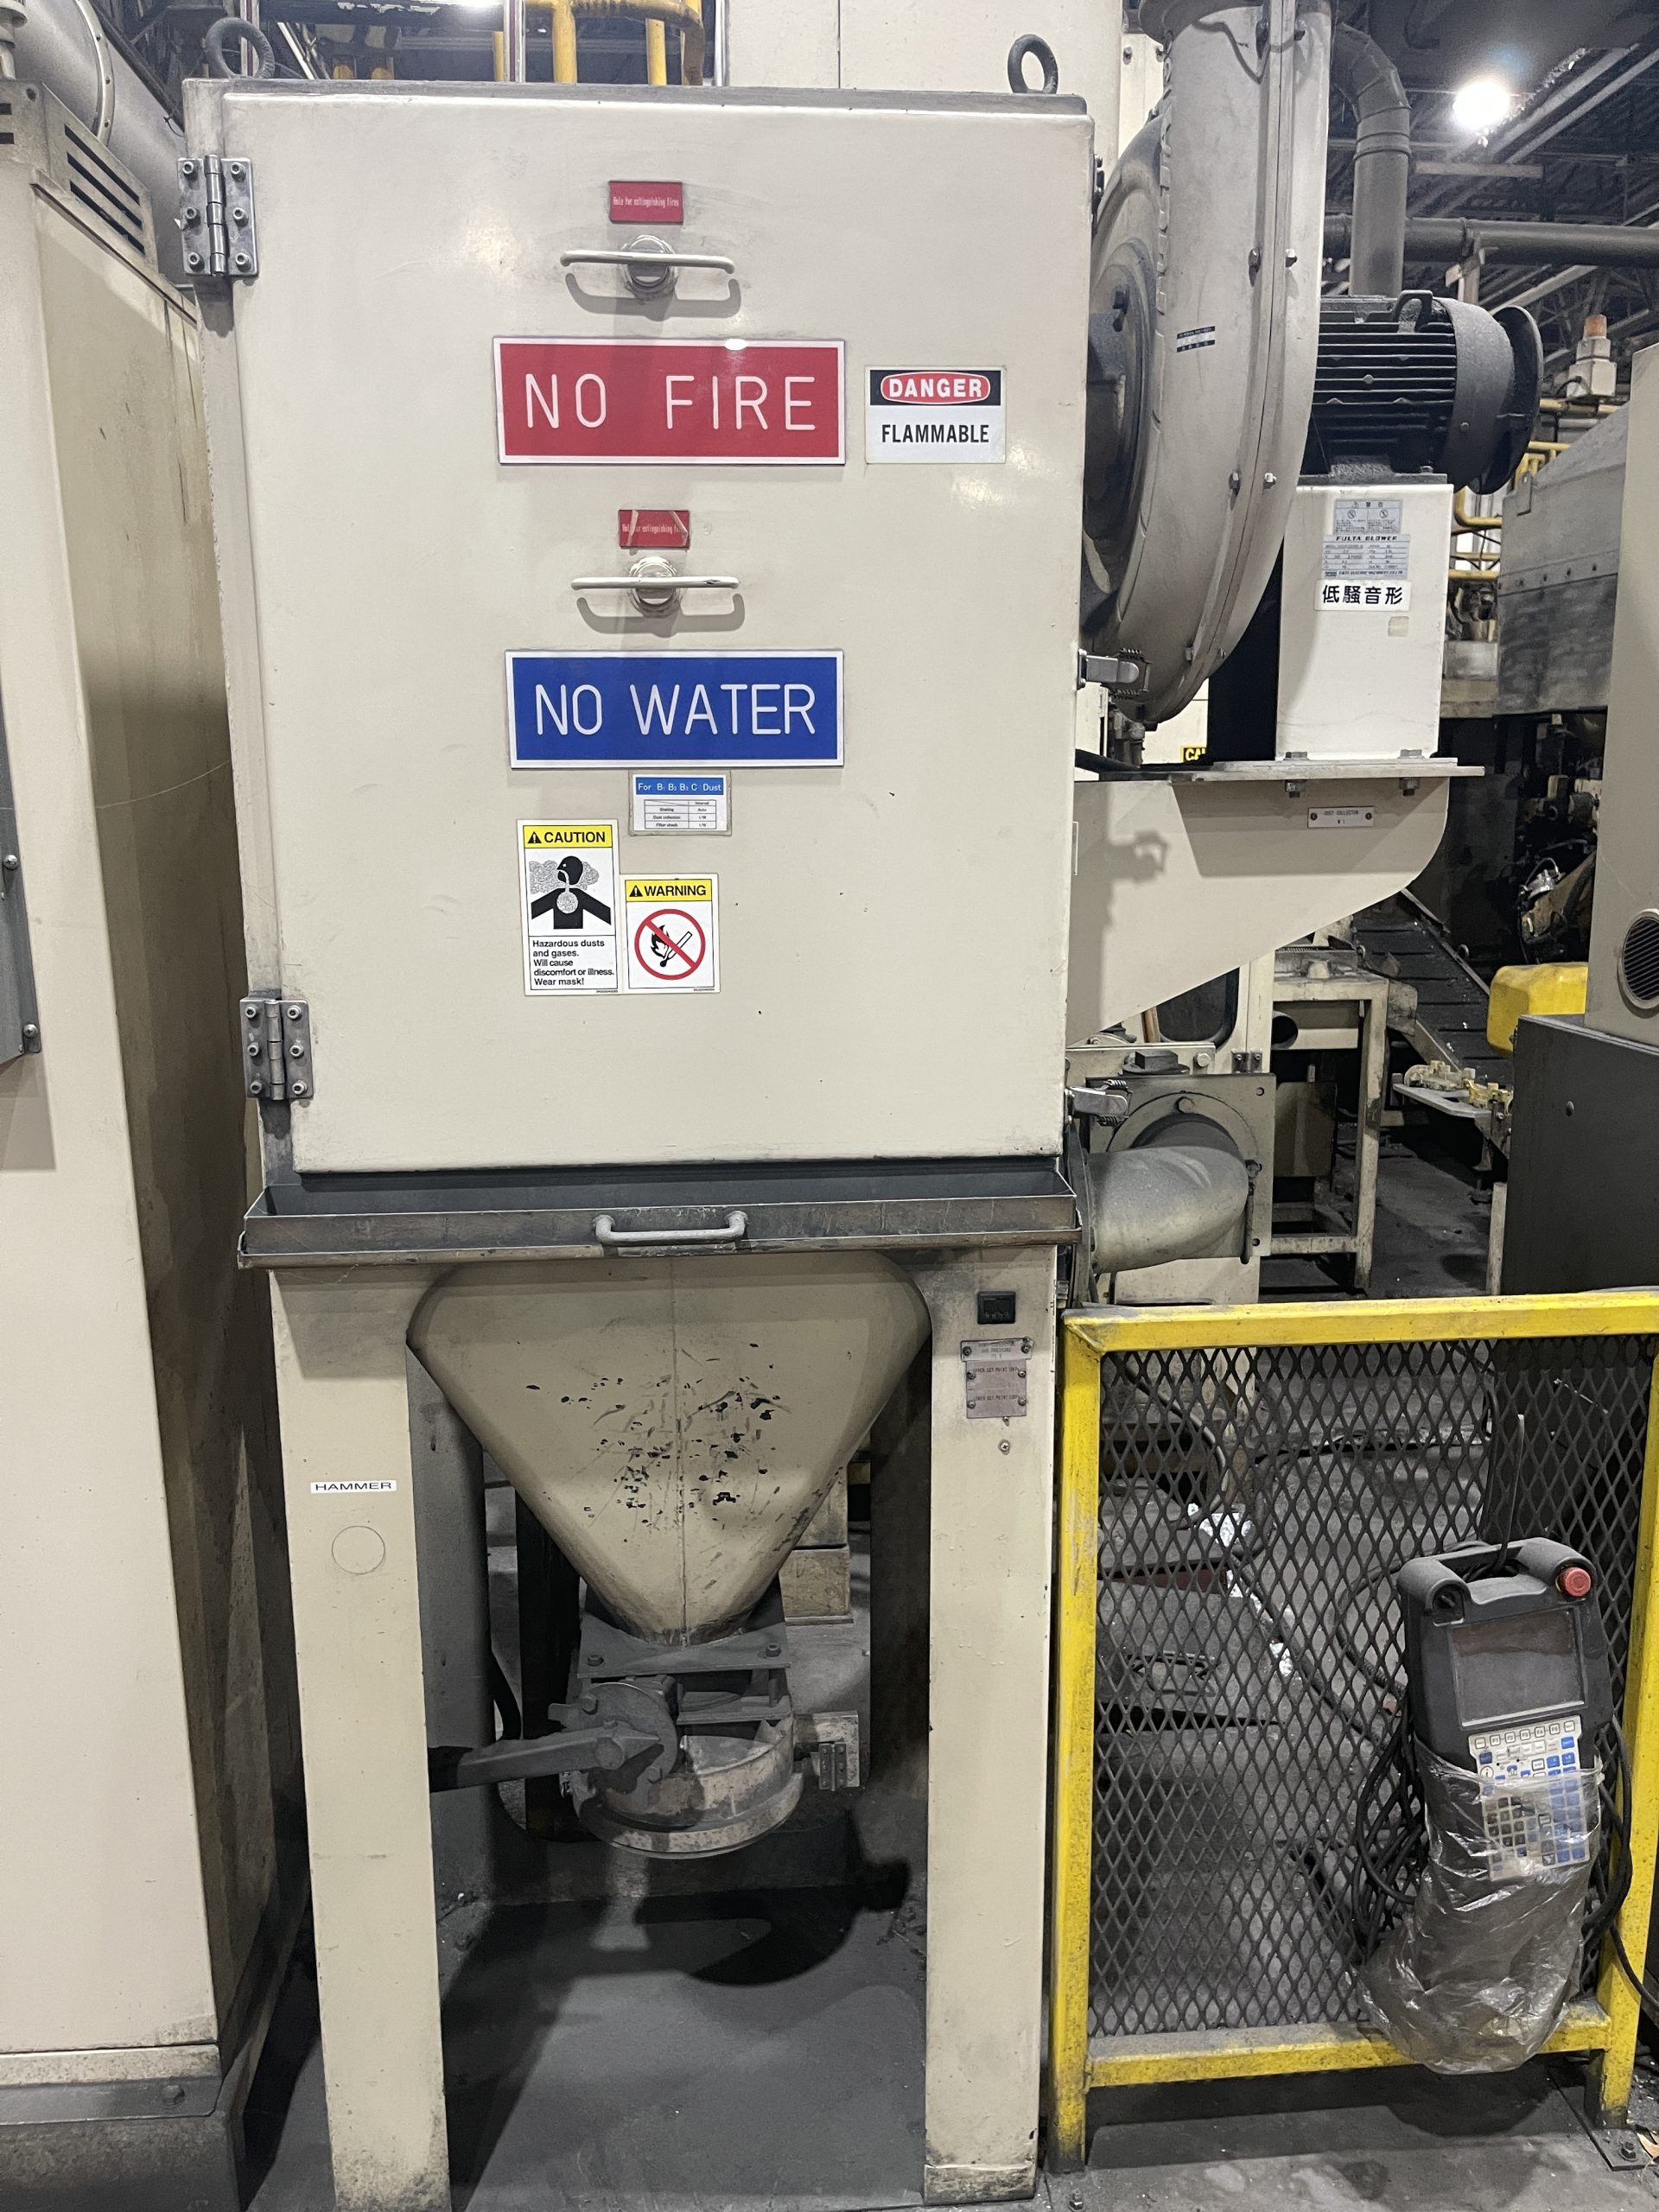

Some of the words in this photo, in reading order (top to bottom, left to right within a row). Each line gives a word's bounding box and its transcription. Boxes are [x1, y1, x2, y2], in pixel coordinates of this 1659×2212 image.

[633, 196, 666, 208] extinguishing
[888, 378, 982, 398] DANGER
[525, 373, 607, 429] NO
[664, 375, 817, 431] FIRE
[881, 424, 989, 443] FLAMMABLE
[642, 524, 673, 535] extinguishing
[1322, 585, 1403, 605] 低騒音形
[535, 683, 603, 735] NO
[629, 683, 816, 735] WATER
[544, 832, 606, 843] CAUTION
[644, 885, 707, 897] WARNING
[551, 950, 580, 958] gases.
[315, 1482, 392, 1491] HAMMER
